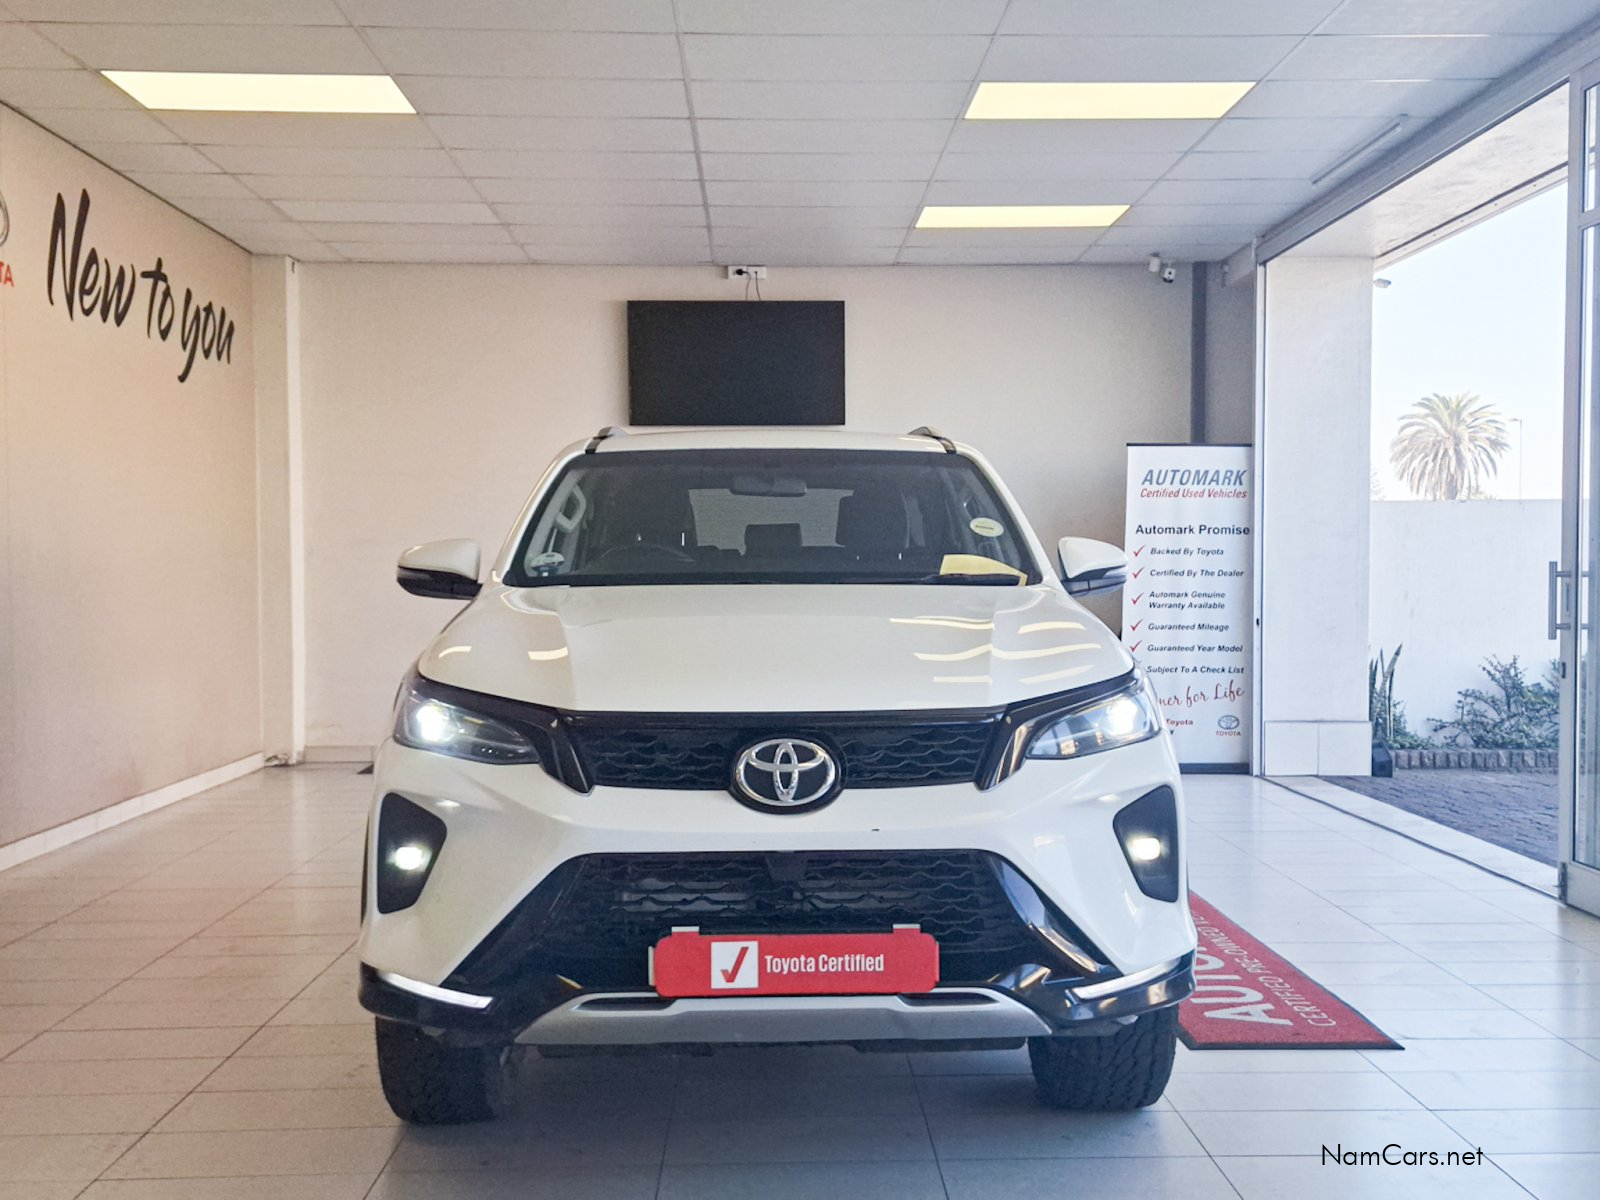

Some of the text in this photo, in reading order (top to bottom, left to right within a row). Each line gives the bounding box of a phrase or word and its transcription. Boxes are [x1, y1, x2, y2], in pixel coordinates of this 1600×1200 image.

[48, 188, 234, 383] New to you
[1141, 469, 1246, 486] AUTOMARK
[1140, 488, 1247, 499] Certified Used Vehicles
[1135, 524, 1250, 535] Automark Promise
[1183, 548, 1194, 556] By
[1196, 548, 1224, 556] Toyota
[1150, 569, 1185, 577] Certified
[1186, 569, 1197, 578] By
[1200, 569, 1215, 577] The
[1149, 602, 1185, 610] Warranty
[1148, 623, 1229, 632] Guaranteed Mileage
[1147, 666, 1178, 675] Subject
[1185, 686, 1208, 708] for
[1214, 680, 1245, 701] Life
[765, 953, 884, 974] Toyota Certified
[1258, 975, 1336, 1027] CERTIFIED
